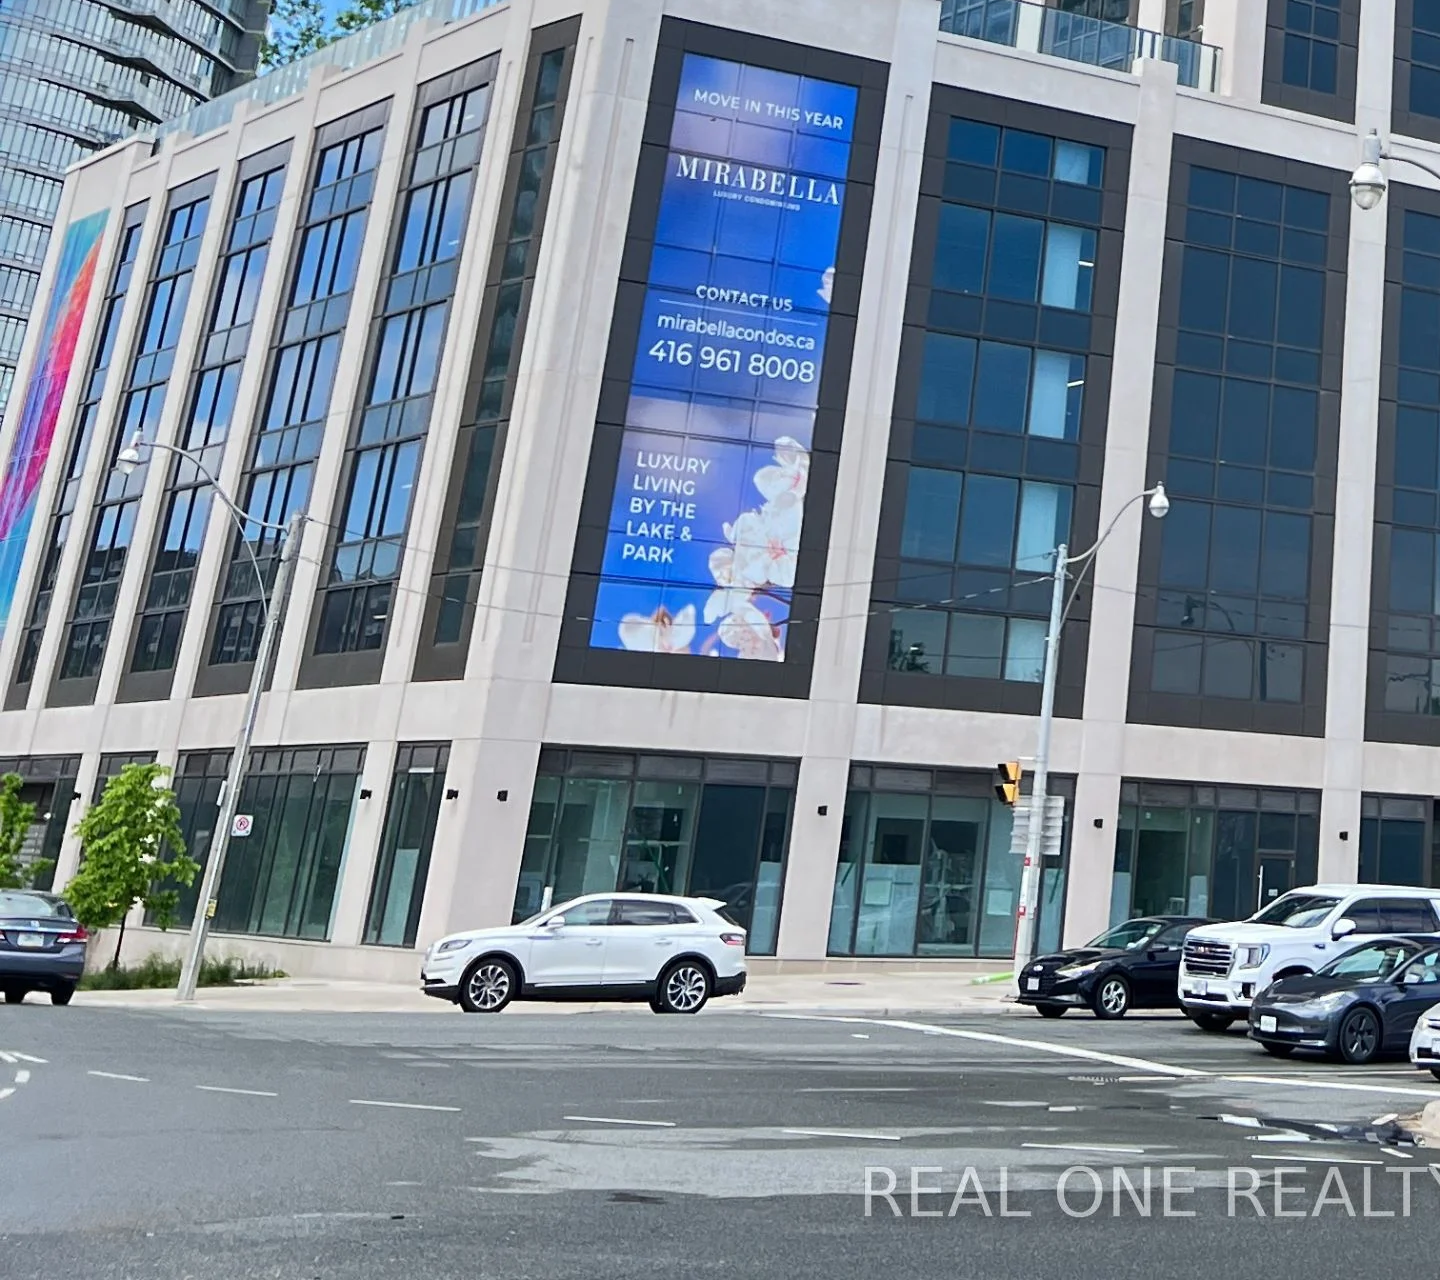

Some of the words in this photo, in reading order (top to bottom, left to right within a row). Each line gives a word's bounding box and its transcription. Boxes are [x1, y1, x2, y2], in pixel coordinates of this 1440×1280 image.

[694, 88, 740, 110] MOVE
[745, 99, 761, 114] IN
[766, 103, 801, 121] THIS
[804, 111, 844, 130] YEAR
[675, 155, 841, 206] MIRABELLA
[696, 285, 769, 308] CONTACT
[772, 297, 793, 312] US
[657, 313, 816, 351] mirabellacondos.ca
[648, 339, 693, 366] 416
[699, 346, 742, 373] 961
[748, 353, 815, 383] 8008
[636, 451, 711, 474] LUXURY
[633, 474, 695, 496] LIVING
[629, 496, 656, 515] BY
[660, 500, 696, 519] THE
[626, 520, 675, 541] LAKE
[680, 526, 693, 541] &
[622, 543, 674, 563] PARK
